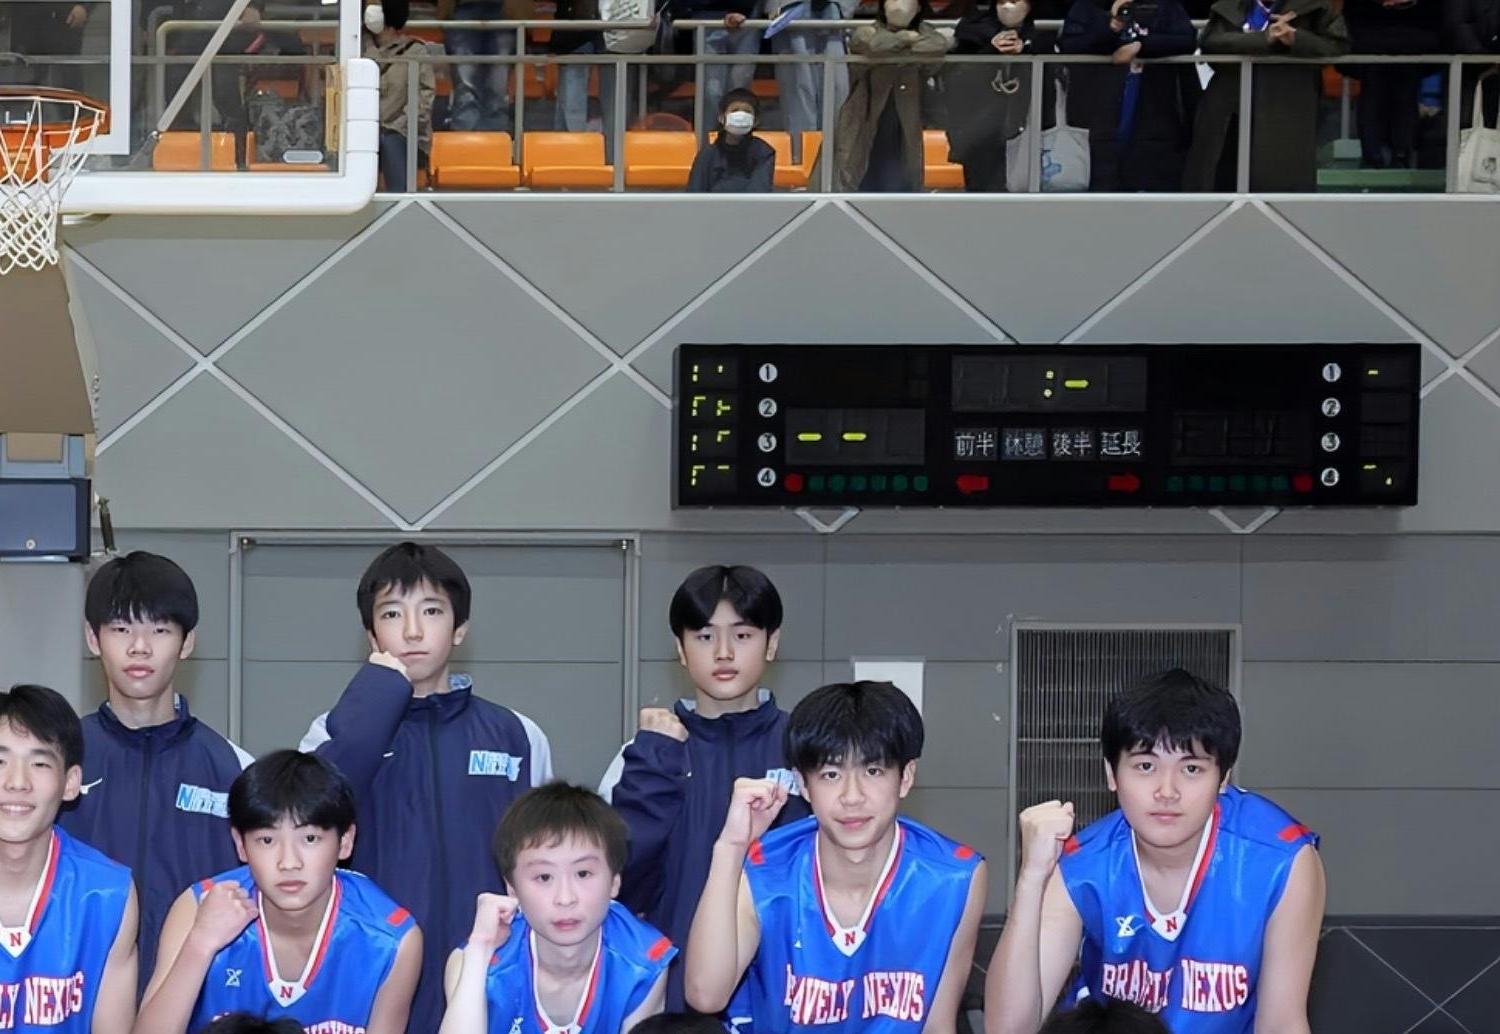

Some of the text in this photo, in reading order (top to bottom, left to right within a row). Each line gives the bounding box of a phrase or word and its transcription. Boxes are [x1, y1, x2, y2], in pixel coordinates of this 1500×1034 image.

[955, 431, 995, 457] 前半
[1053, 431, 1092, 457] 後半
[1100, 430, 1141, 456] 延長
[862, 971, 926, 1023] NEXUS
[1181, 959, 1249, 1013] NEXUS
